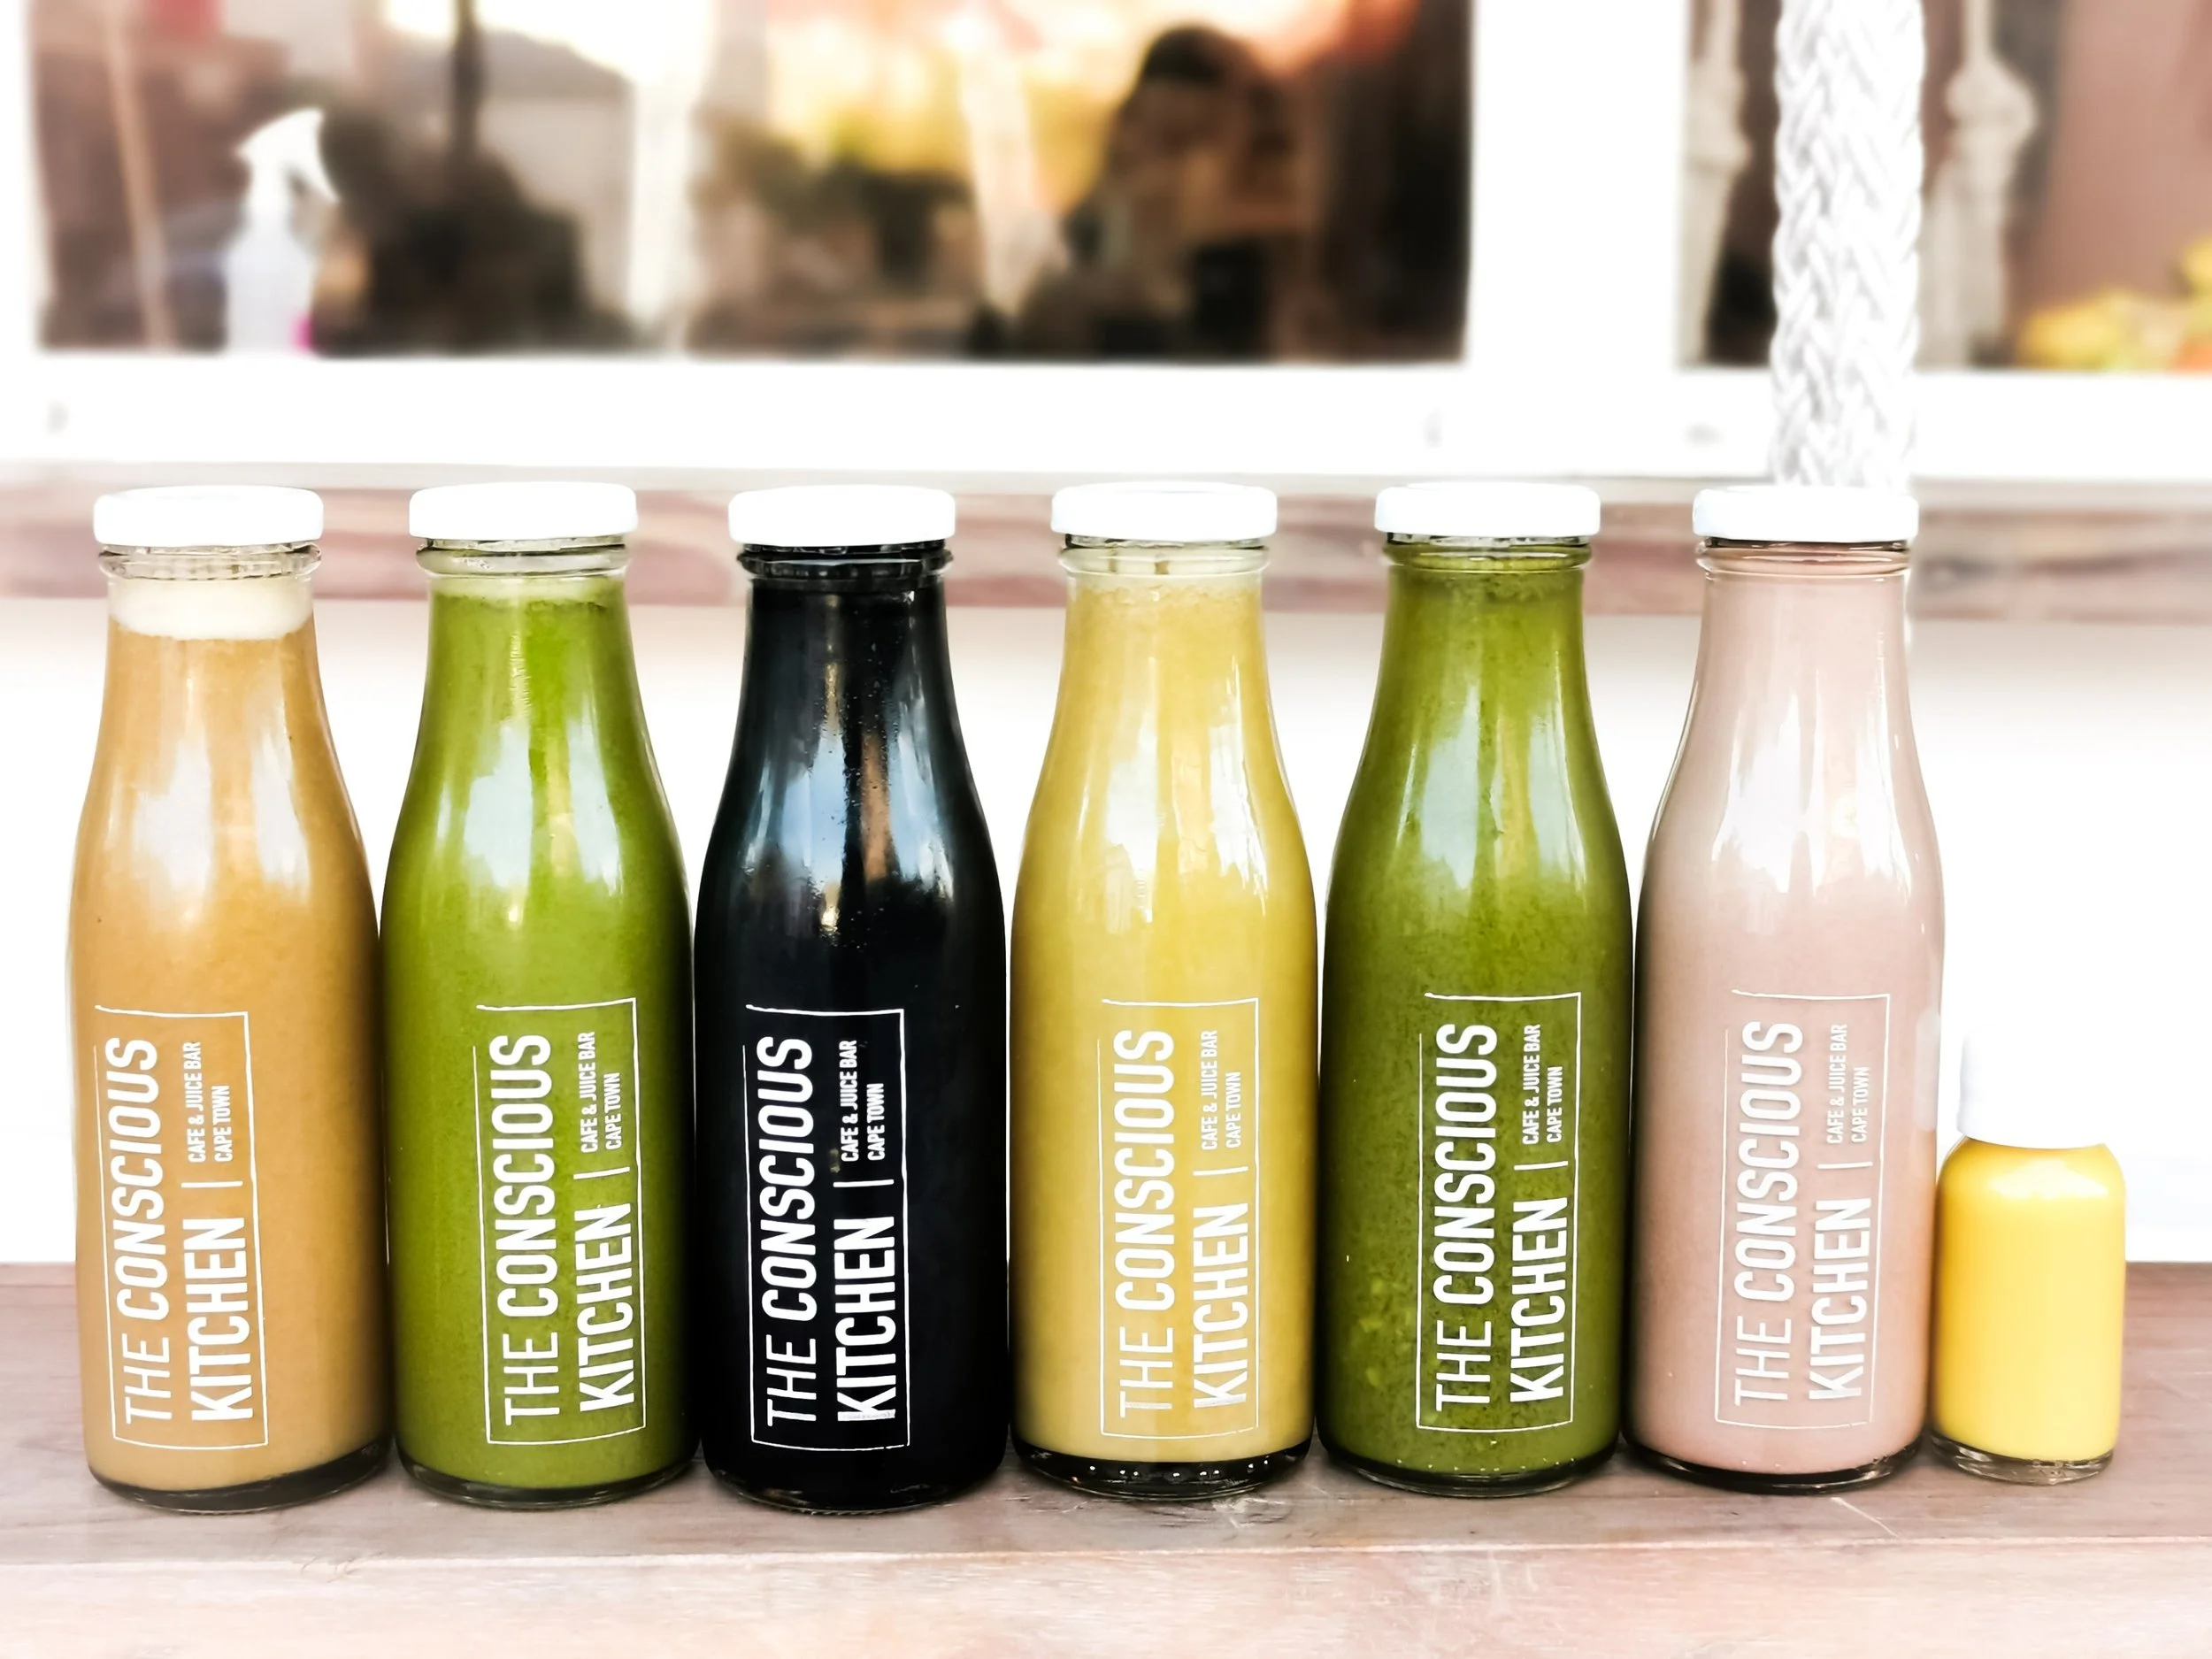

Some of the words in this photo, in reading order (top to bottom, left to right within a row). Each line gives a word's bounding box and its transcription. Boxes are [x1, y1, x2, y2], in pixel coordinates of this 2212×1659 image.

[183, 1041, 202, 1070] BAR
[578, 1032, 596, 1060] BAR
[838, 1041, 856, 1068] BAR
[1201, 1030, 1217, 1057] BAR
[1523, 1025, 1541, 1052] BAR
[1829, 1024, 1847, 1051] BAR
[185, 1071, 204, 1111] JUICE
[579, 1061, 597, 1102] JUICE
[603, 1072, 621, 1110] TOWN
[840, 1070, 858, 1110] JUICE
[1201, 1059, 1217, 1099] JUICE
[1225, 1071, 1241, 1110] TOWN
[1523, 1054, 1540, 1093] JUICE
[1547, 1066, 1563, 1104] TOWN
[1828, 1053, 1847, 1093] JUICE
[1852, 1066, 1870, 1104] TOWN
[187, 1113, 204, 1125] &
[212, 1085, 231, 1124] TOWN
[580, 1103, 597, 1116] &
[841, 1112, 858, 1124] &
[866, 1082, 885, 1122] TOWN
[1202, 1101, 1217, 1113] &
[1523, 1095, 1540, 1107] &
[1827, 1094, 1846, 1106] &
[580, 1118, 598, 1152] CAFE
[605, 1111, 622, 1149] CAPE
[868, 1124, 886, 1160] CAPE
[1201, 1115, 1217, 1150] CAFE
[1225, 1110, 1241, 1148] CAPE
[1523, 1110, 1540, 1144] CAFE
[1547, 1105, 1563, 1142] CAPE
[1826, 1109, 1846, 1144] CAFE
[1851, 1105, 1868, 1142] CAPE
[187, 1128, 206, 1163] CAFE
[214, 1125, 233, 1162] CAPE
[841, 1126, 859, 1162] CAFE
[1733, 1021, 1803, 1302] CONSCIOUS
[105, 1037, 169, 1321] CONSCIOUS
[489, 1034, 559, 1317] CONSCIOUS
[757, 1038, 817, 1321] CONSCIOUS
[1114, 1029, 1175, 1310] CONSCIOUS
[1433, 1024, 1497, 1304] CONSCIOUS
[574, 1203, 634, 1411] KITCHEN
[834, 1216, 895, 1420] KITCHEN
[1194, 1202, 1248, 1408] KITCHEN
[1510, 1197, 1567, 1402] KITCHEN
[1809, 1198, 1870, 1400] KITCHEN
[183, 1217, 253, 1420] KITCHEN
[122, 1333, 171, 1425] THE
[503, 1332, 559, 1425] THE
[765, 1333, 817, 1425] THE
[1119, 1325, 1174, 1417] THE
[1435, 1320, 1492, 1410] THE
[1734, 1317, 1791, 1406] THE
